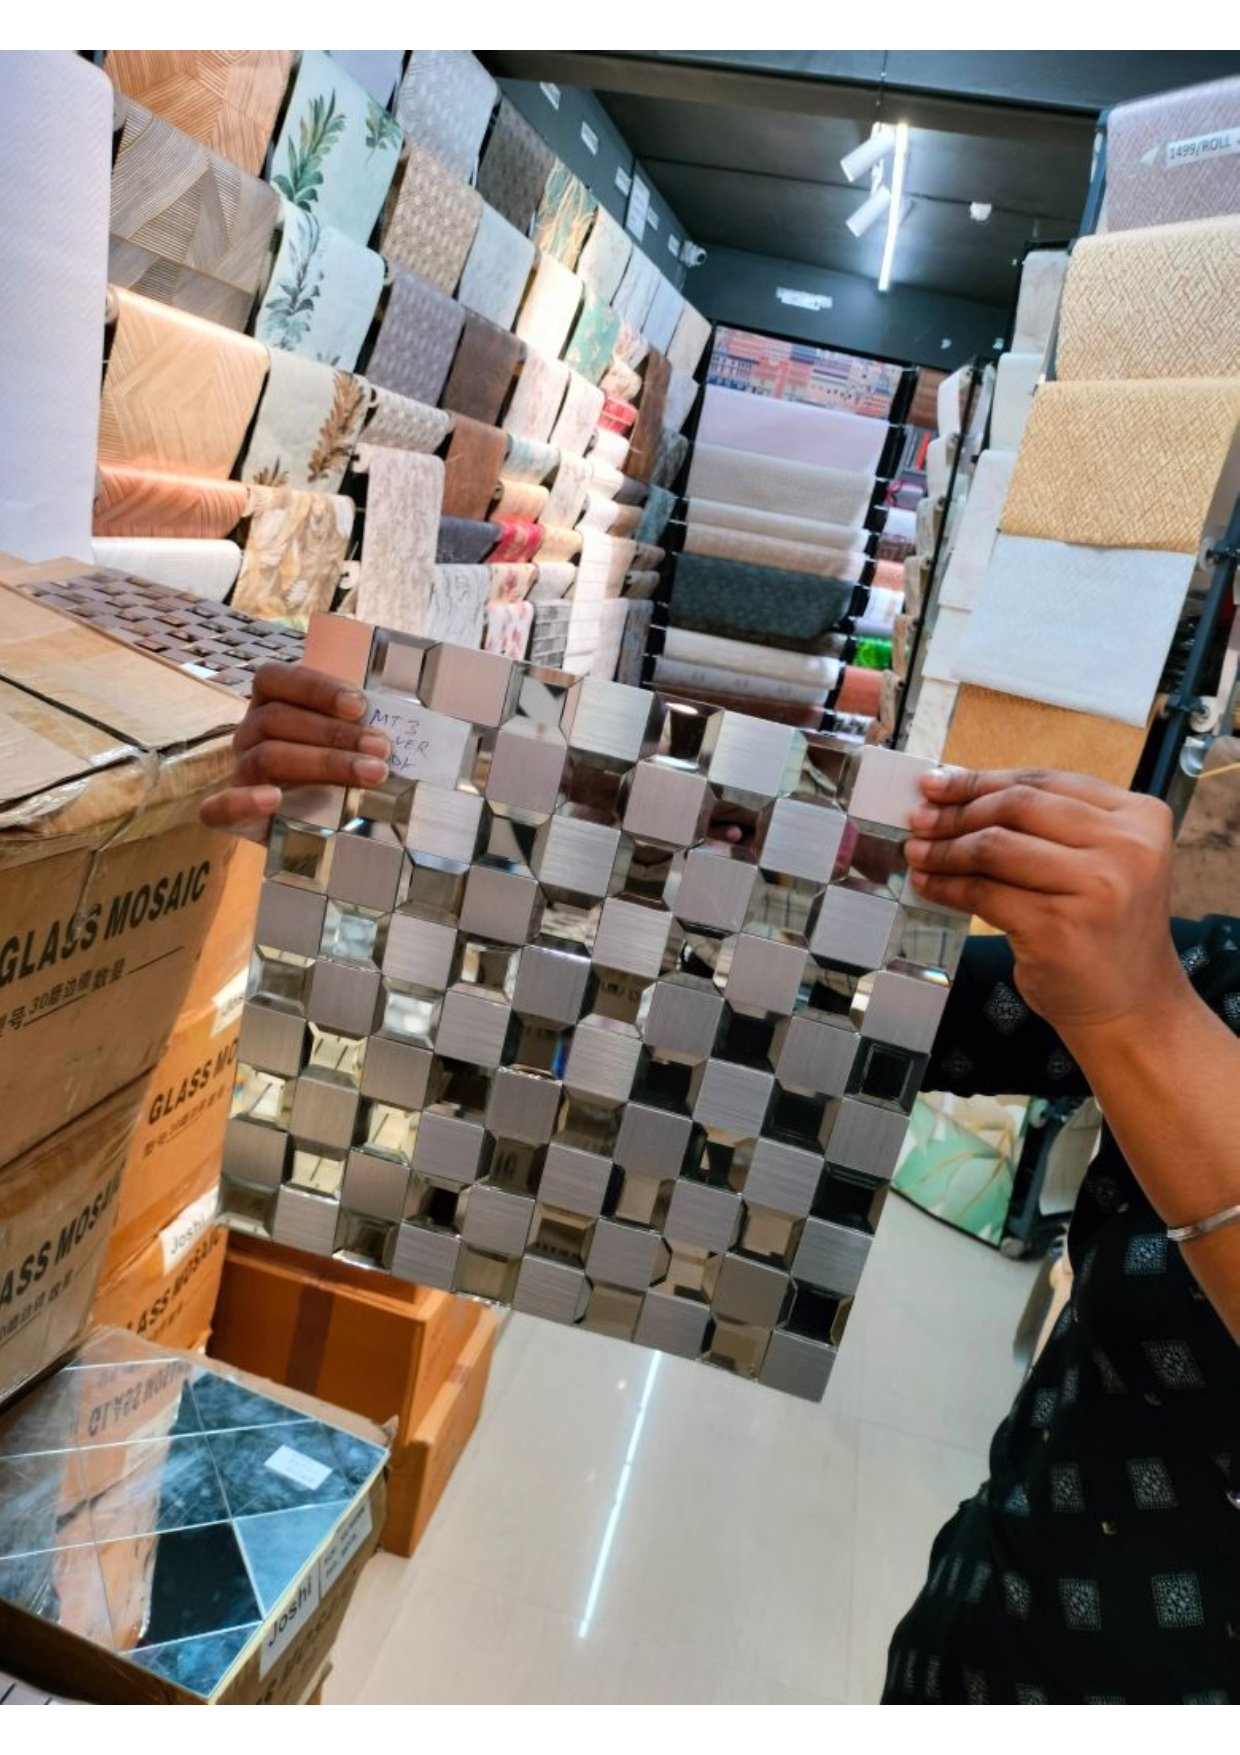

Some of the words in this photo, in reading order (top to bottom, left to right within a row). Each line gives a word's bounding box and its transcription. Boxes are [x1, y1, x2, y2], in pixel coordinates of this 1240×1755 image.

[395, 736, 429, 757] VER
[0, 903, 103, 987] GLASS
[103, 860, 210, 941] MOSAIC
[149, 1059, 212, 1125] GLASS
[0, 1240, 51, 1307] ASS
[268, 1574, 312, 1647] Joshi
